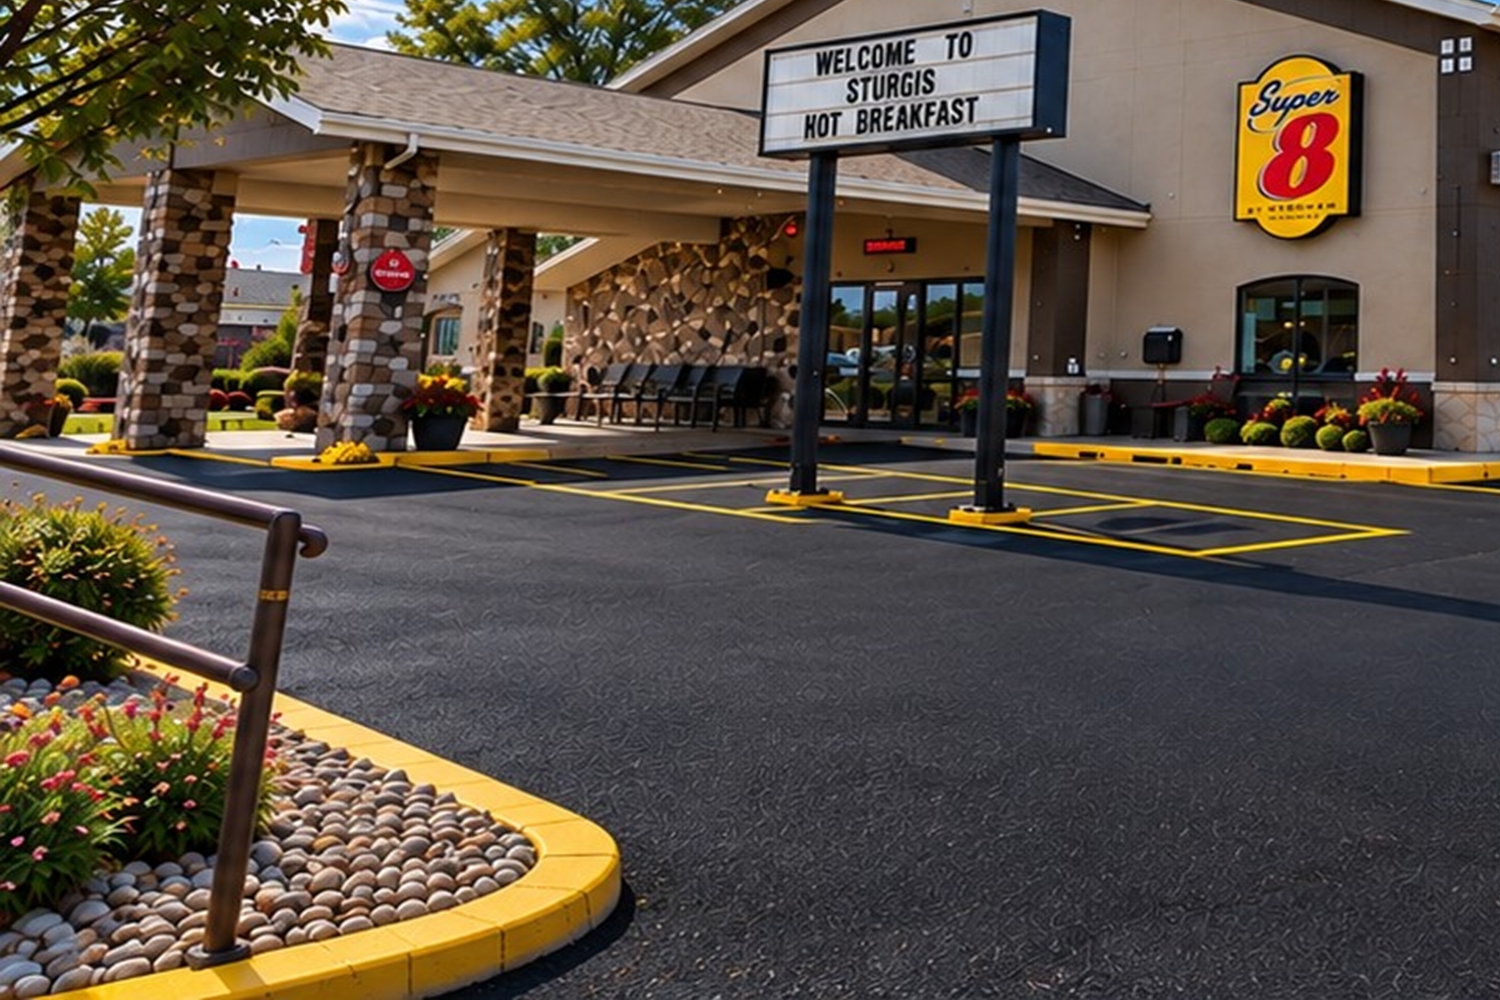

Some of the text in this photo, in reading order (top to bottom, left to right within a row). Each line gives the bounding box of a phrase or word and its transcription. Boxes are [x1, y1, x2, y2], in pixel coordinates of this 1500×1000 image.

[816, 31, 974, 75] WELCOME TO
[846, 69, 936, 104] STURGIS
[1250, 79, 1340, 129] Super
[804, 96, 980, 140] HOT BREAKFAST
[1256, 112, 1340, 202] 8
